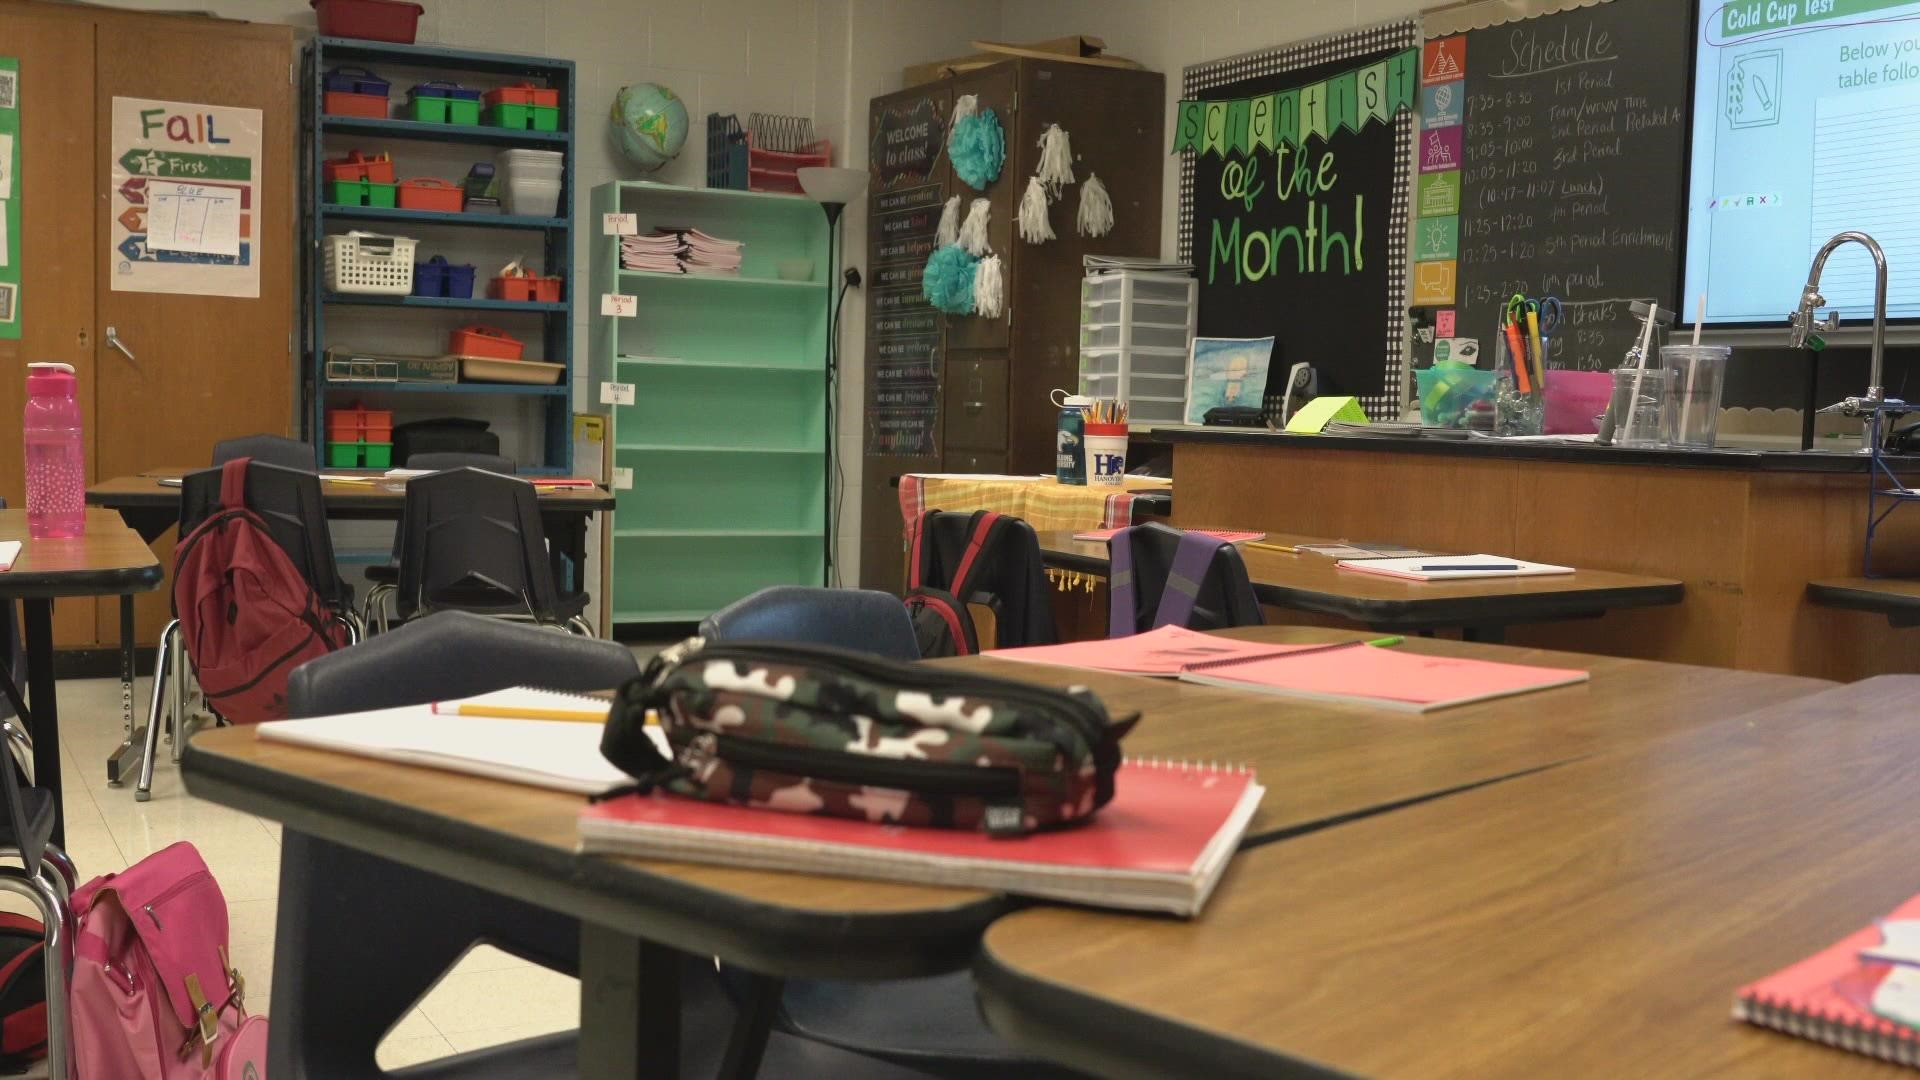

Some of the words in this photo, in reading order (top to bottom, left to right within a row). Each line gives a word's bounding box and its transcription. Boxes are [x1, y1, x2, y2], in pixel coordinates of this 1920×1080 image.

[1727, 3, 1761, 30] Cold
[1767, 0, 1797, 25] Cup
[1805, 0, 1834, 15] Test
[1502, 21, 1613, 75] Schedule
[1840, 41, 1889, 62] Below
[1894, 39, 1920, 59] you
[1578, 69, 1615, 90] Period
[1839, 67, 1878, 88] table
[1882, 61, 1920, 82] follo
[886, 122, 929, 144] WELCOME
[1577, 116, 1615, 136] Period
[886, 150, 897, 166] to
[899, 140, 928, 164] class!
[1583, 136, 1622, 163] Period
[168, 157, 208, 174] First
[1221, 156, 1264, 212] of
[1277, 142, 1337, 200] the
[1208, 194, 1364, 285] Month!
[1573, 303, 1617, 326] Breaks
[879, 430, 924, 449] anything!
